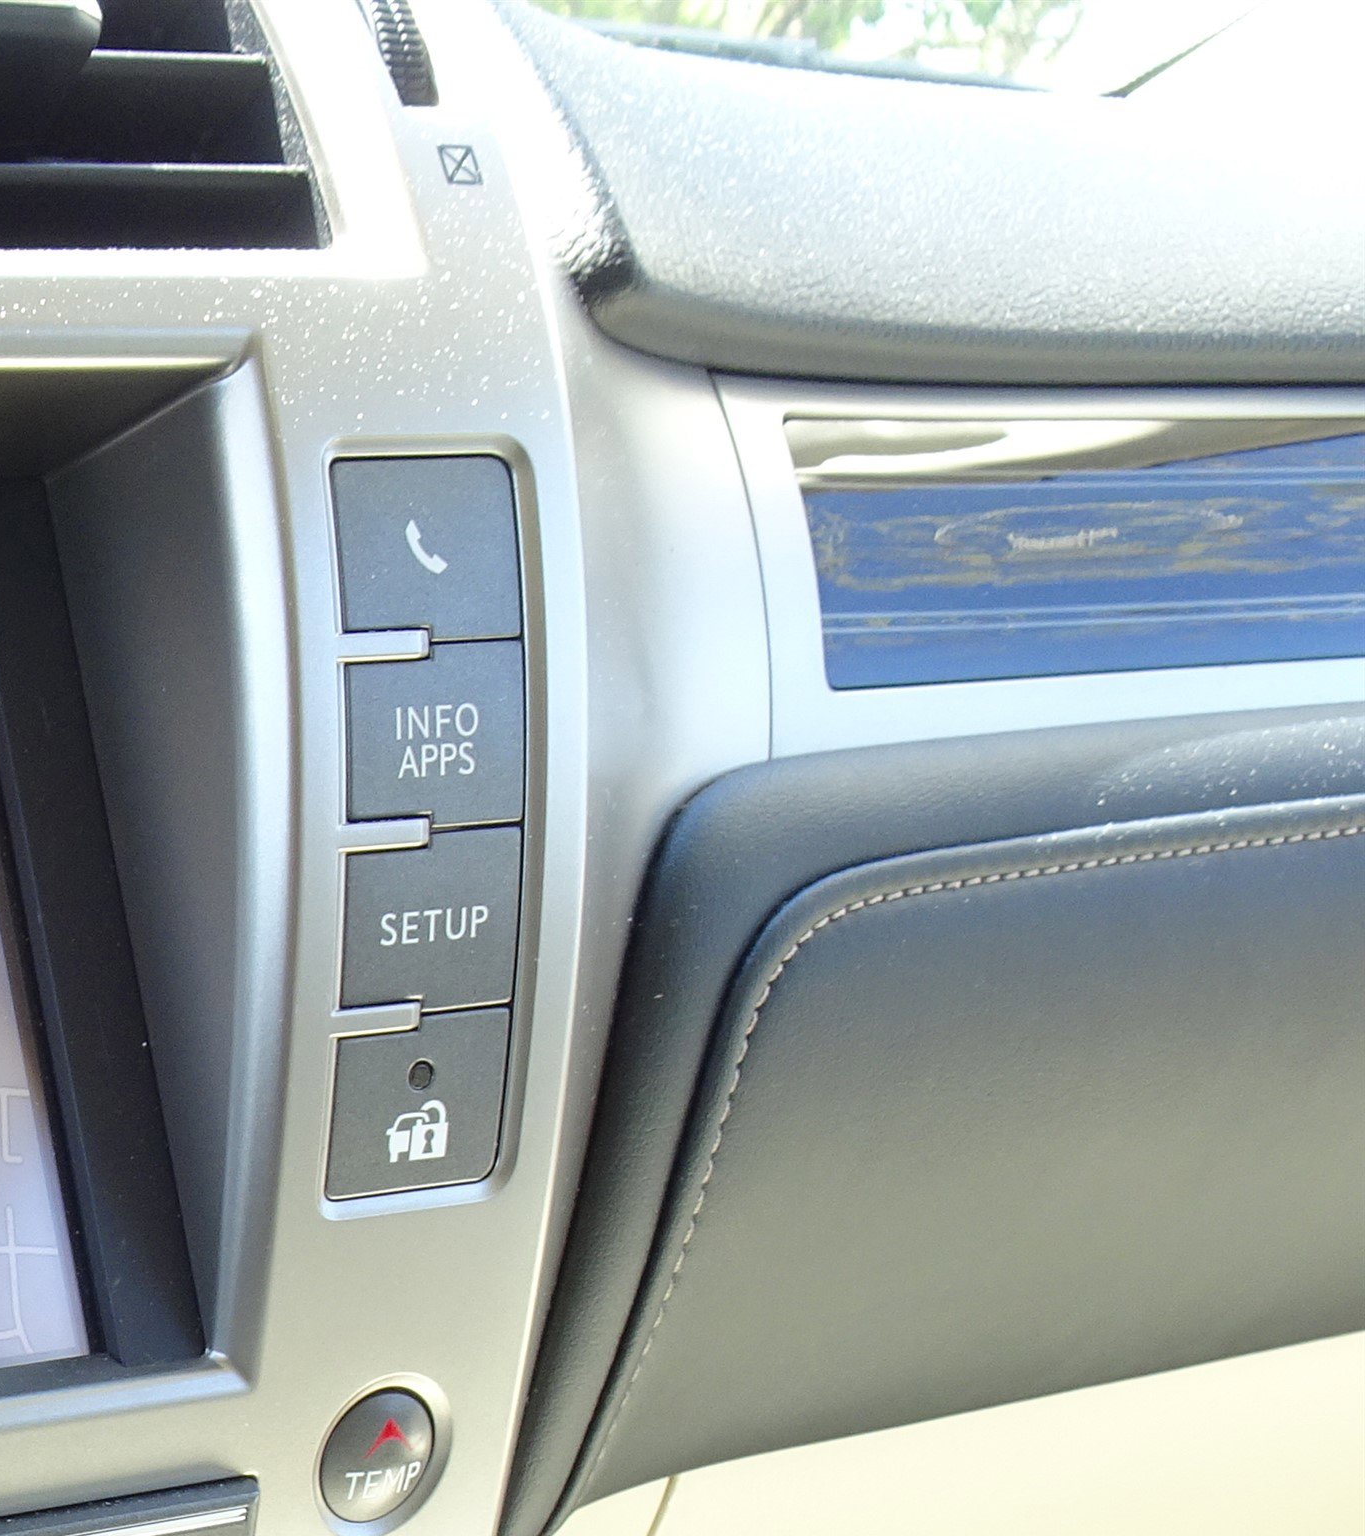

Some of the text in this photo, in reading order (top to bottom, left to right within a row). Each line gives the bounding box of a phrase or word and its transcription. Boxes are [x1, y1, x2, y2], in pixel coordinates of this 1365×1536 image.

[395, 703, 479, 741] INFO
[398, 742, 476, 779] APPS
[380, 905, 488, 946] SETUP
[344, 1461, 422, 1500] TEMP
